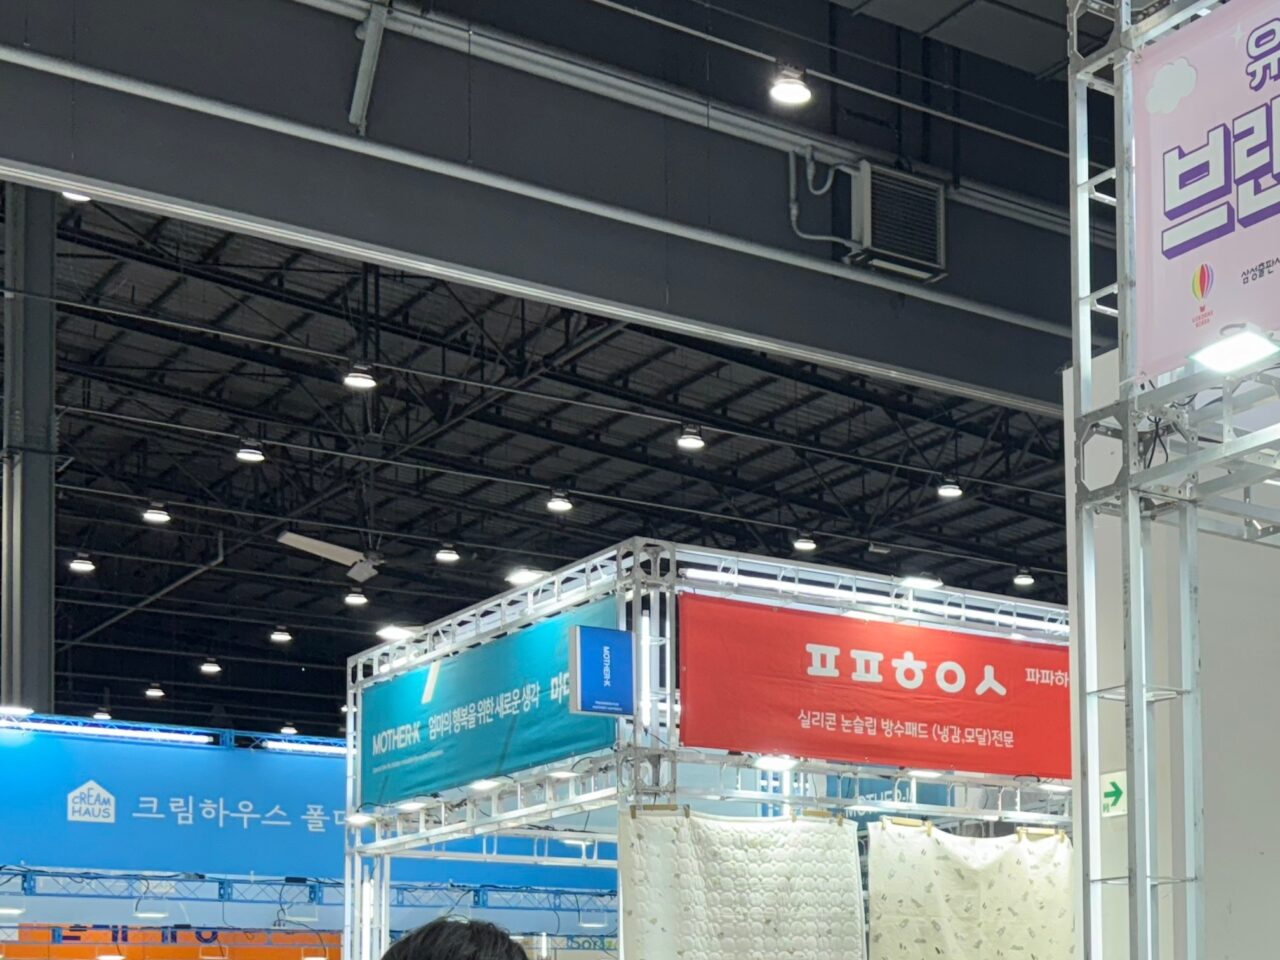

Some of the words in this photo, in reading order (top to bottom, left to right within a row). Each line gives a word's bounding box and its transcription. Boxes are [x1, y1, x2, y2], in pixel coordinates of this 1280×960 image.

[798, 709, 838, 732] 실리콘
[841, 715, 878, 737] 논슬립
[880, 719, 929, 740] 방수패드
[72, 805, 111, 819] HAUS
[132, 796, 292, 828] 크림하우스
